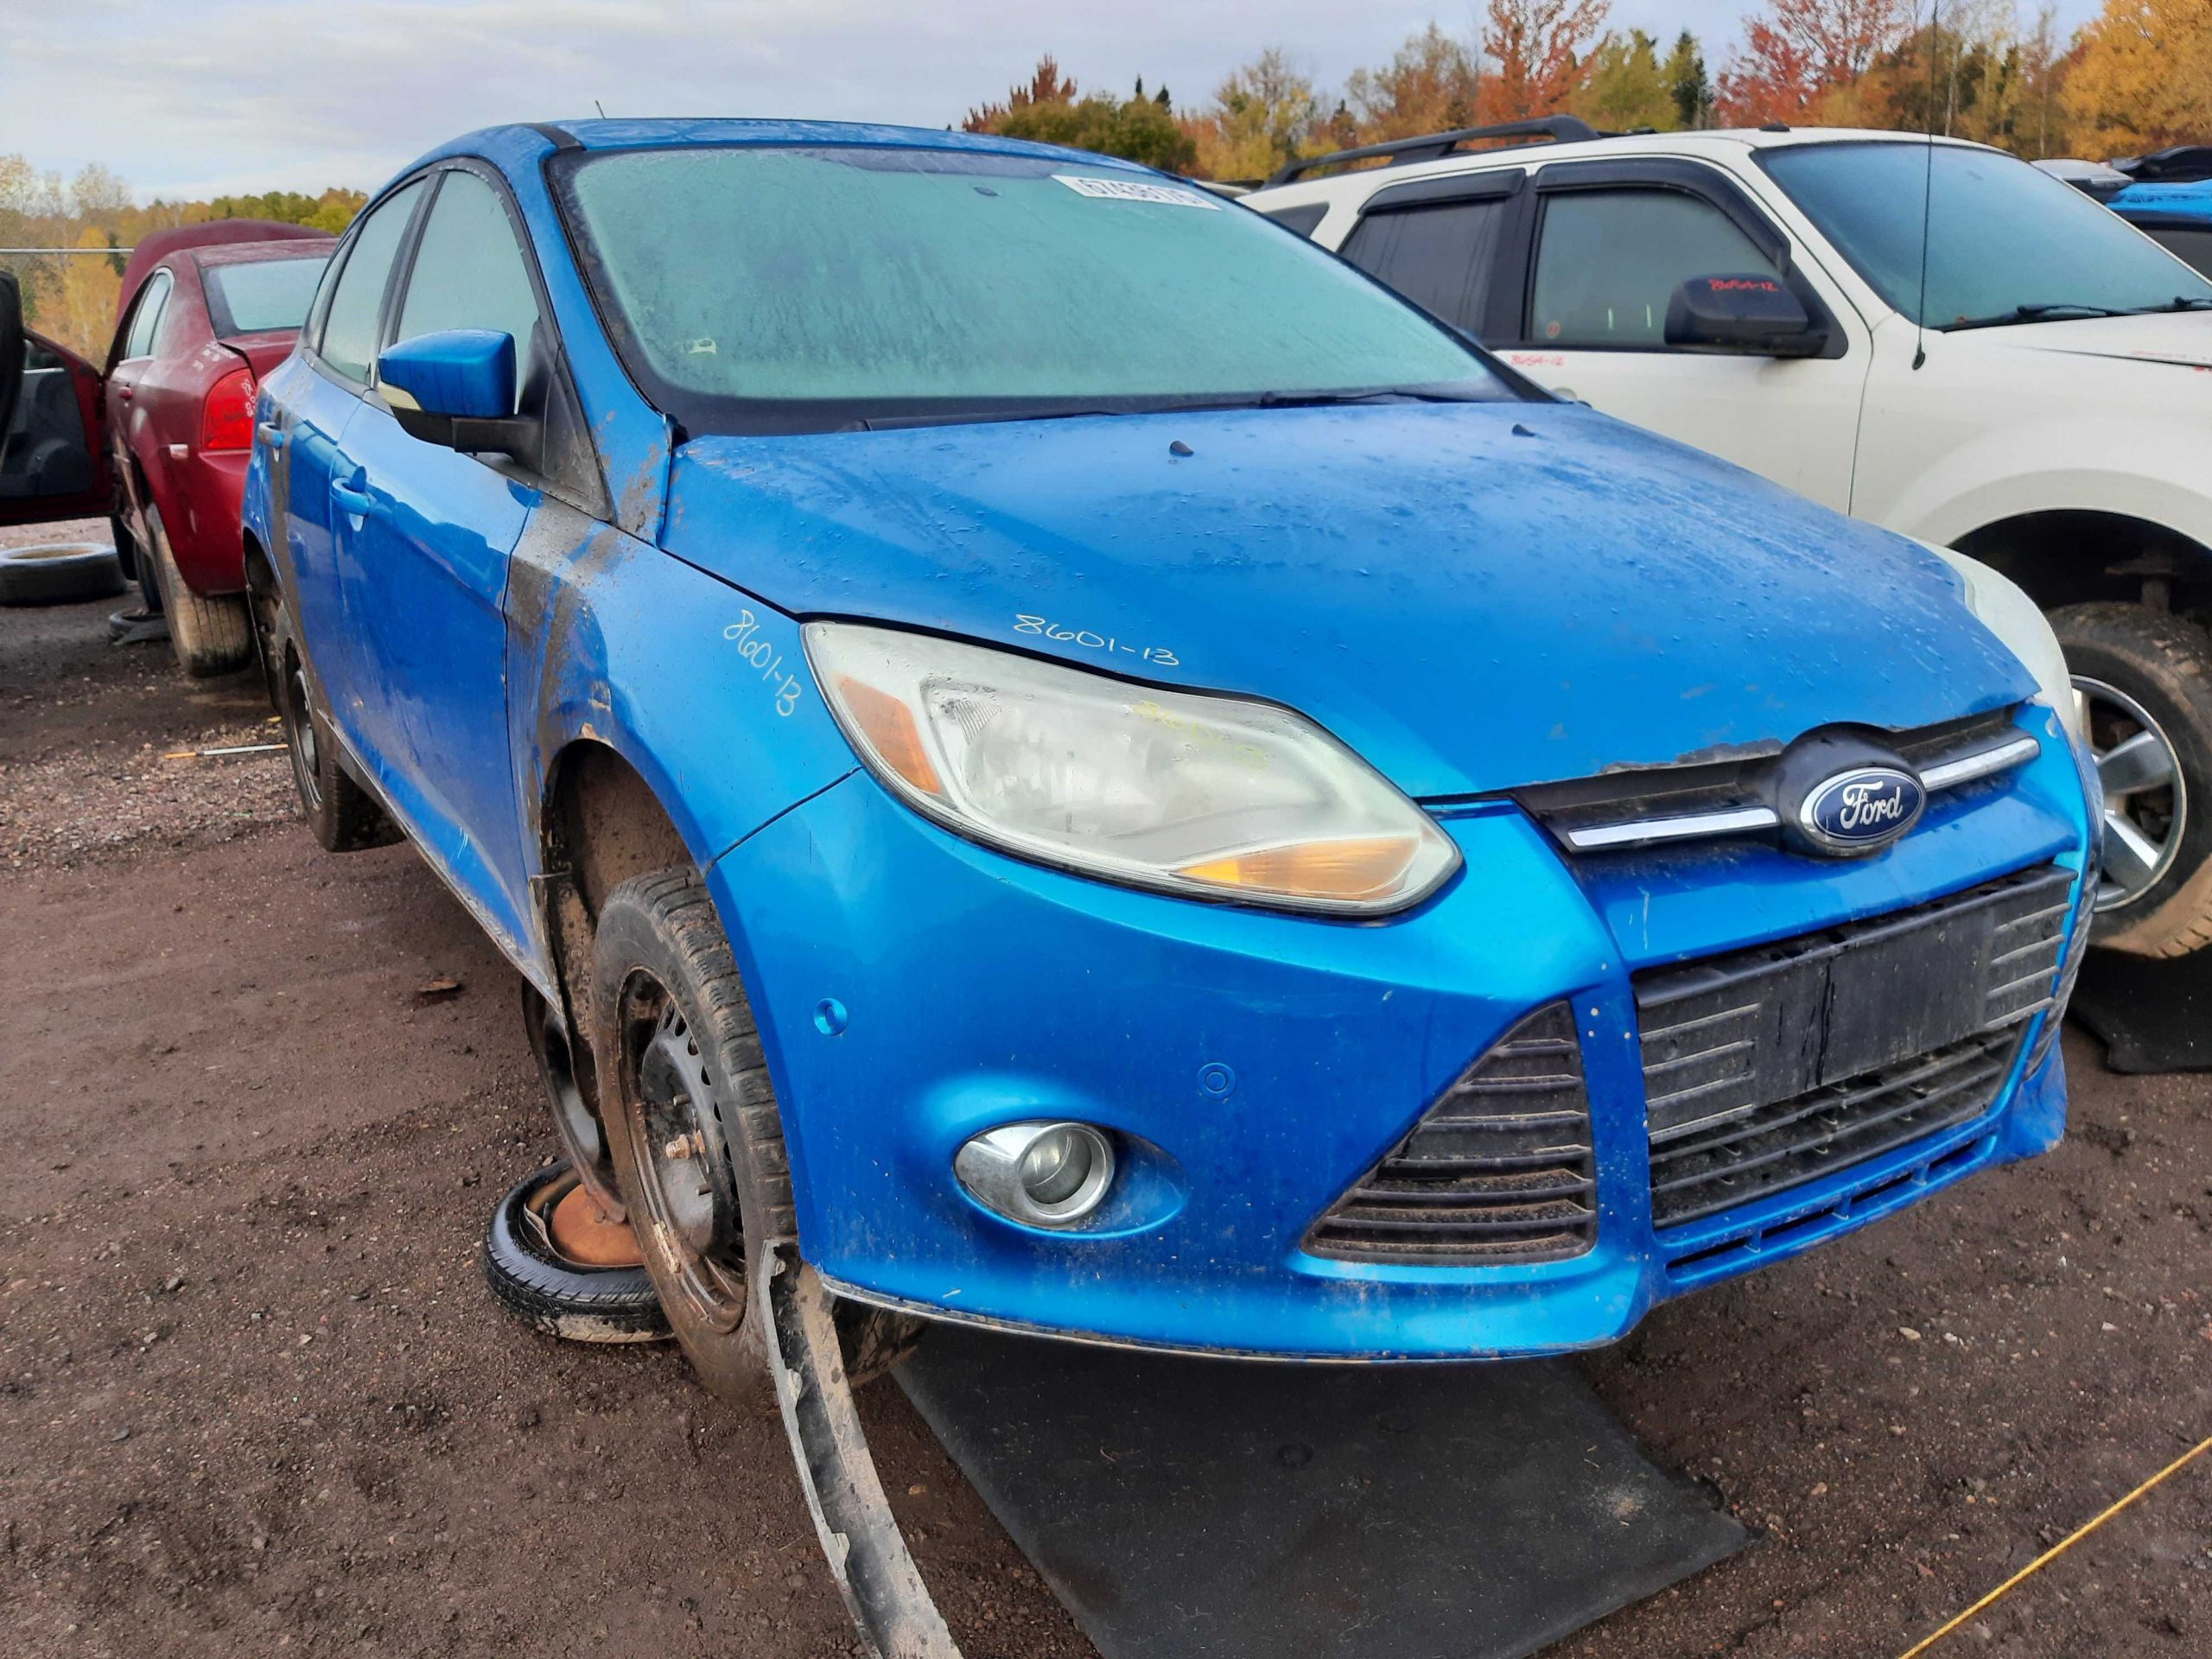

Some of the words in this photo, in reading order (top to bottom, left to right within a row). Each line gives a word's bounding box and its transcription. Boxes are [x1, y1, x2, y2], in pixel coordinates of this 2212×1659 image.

[723, 608, 803, 717] 8601-13
[1013, 613, 1180, 666] 8601-13
[1839, 779, 1904, 830] Ford
